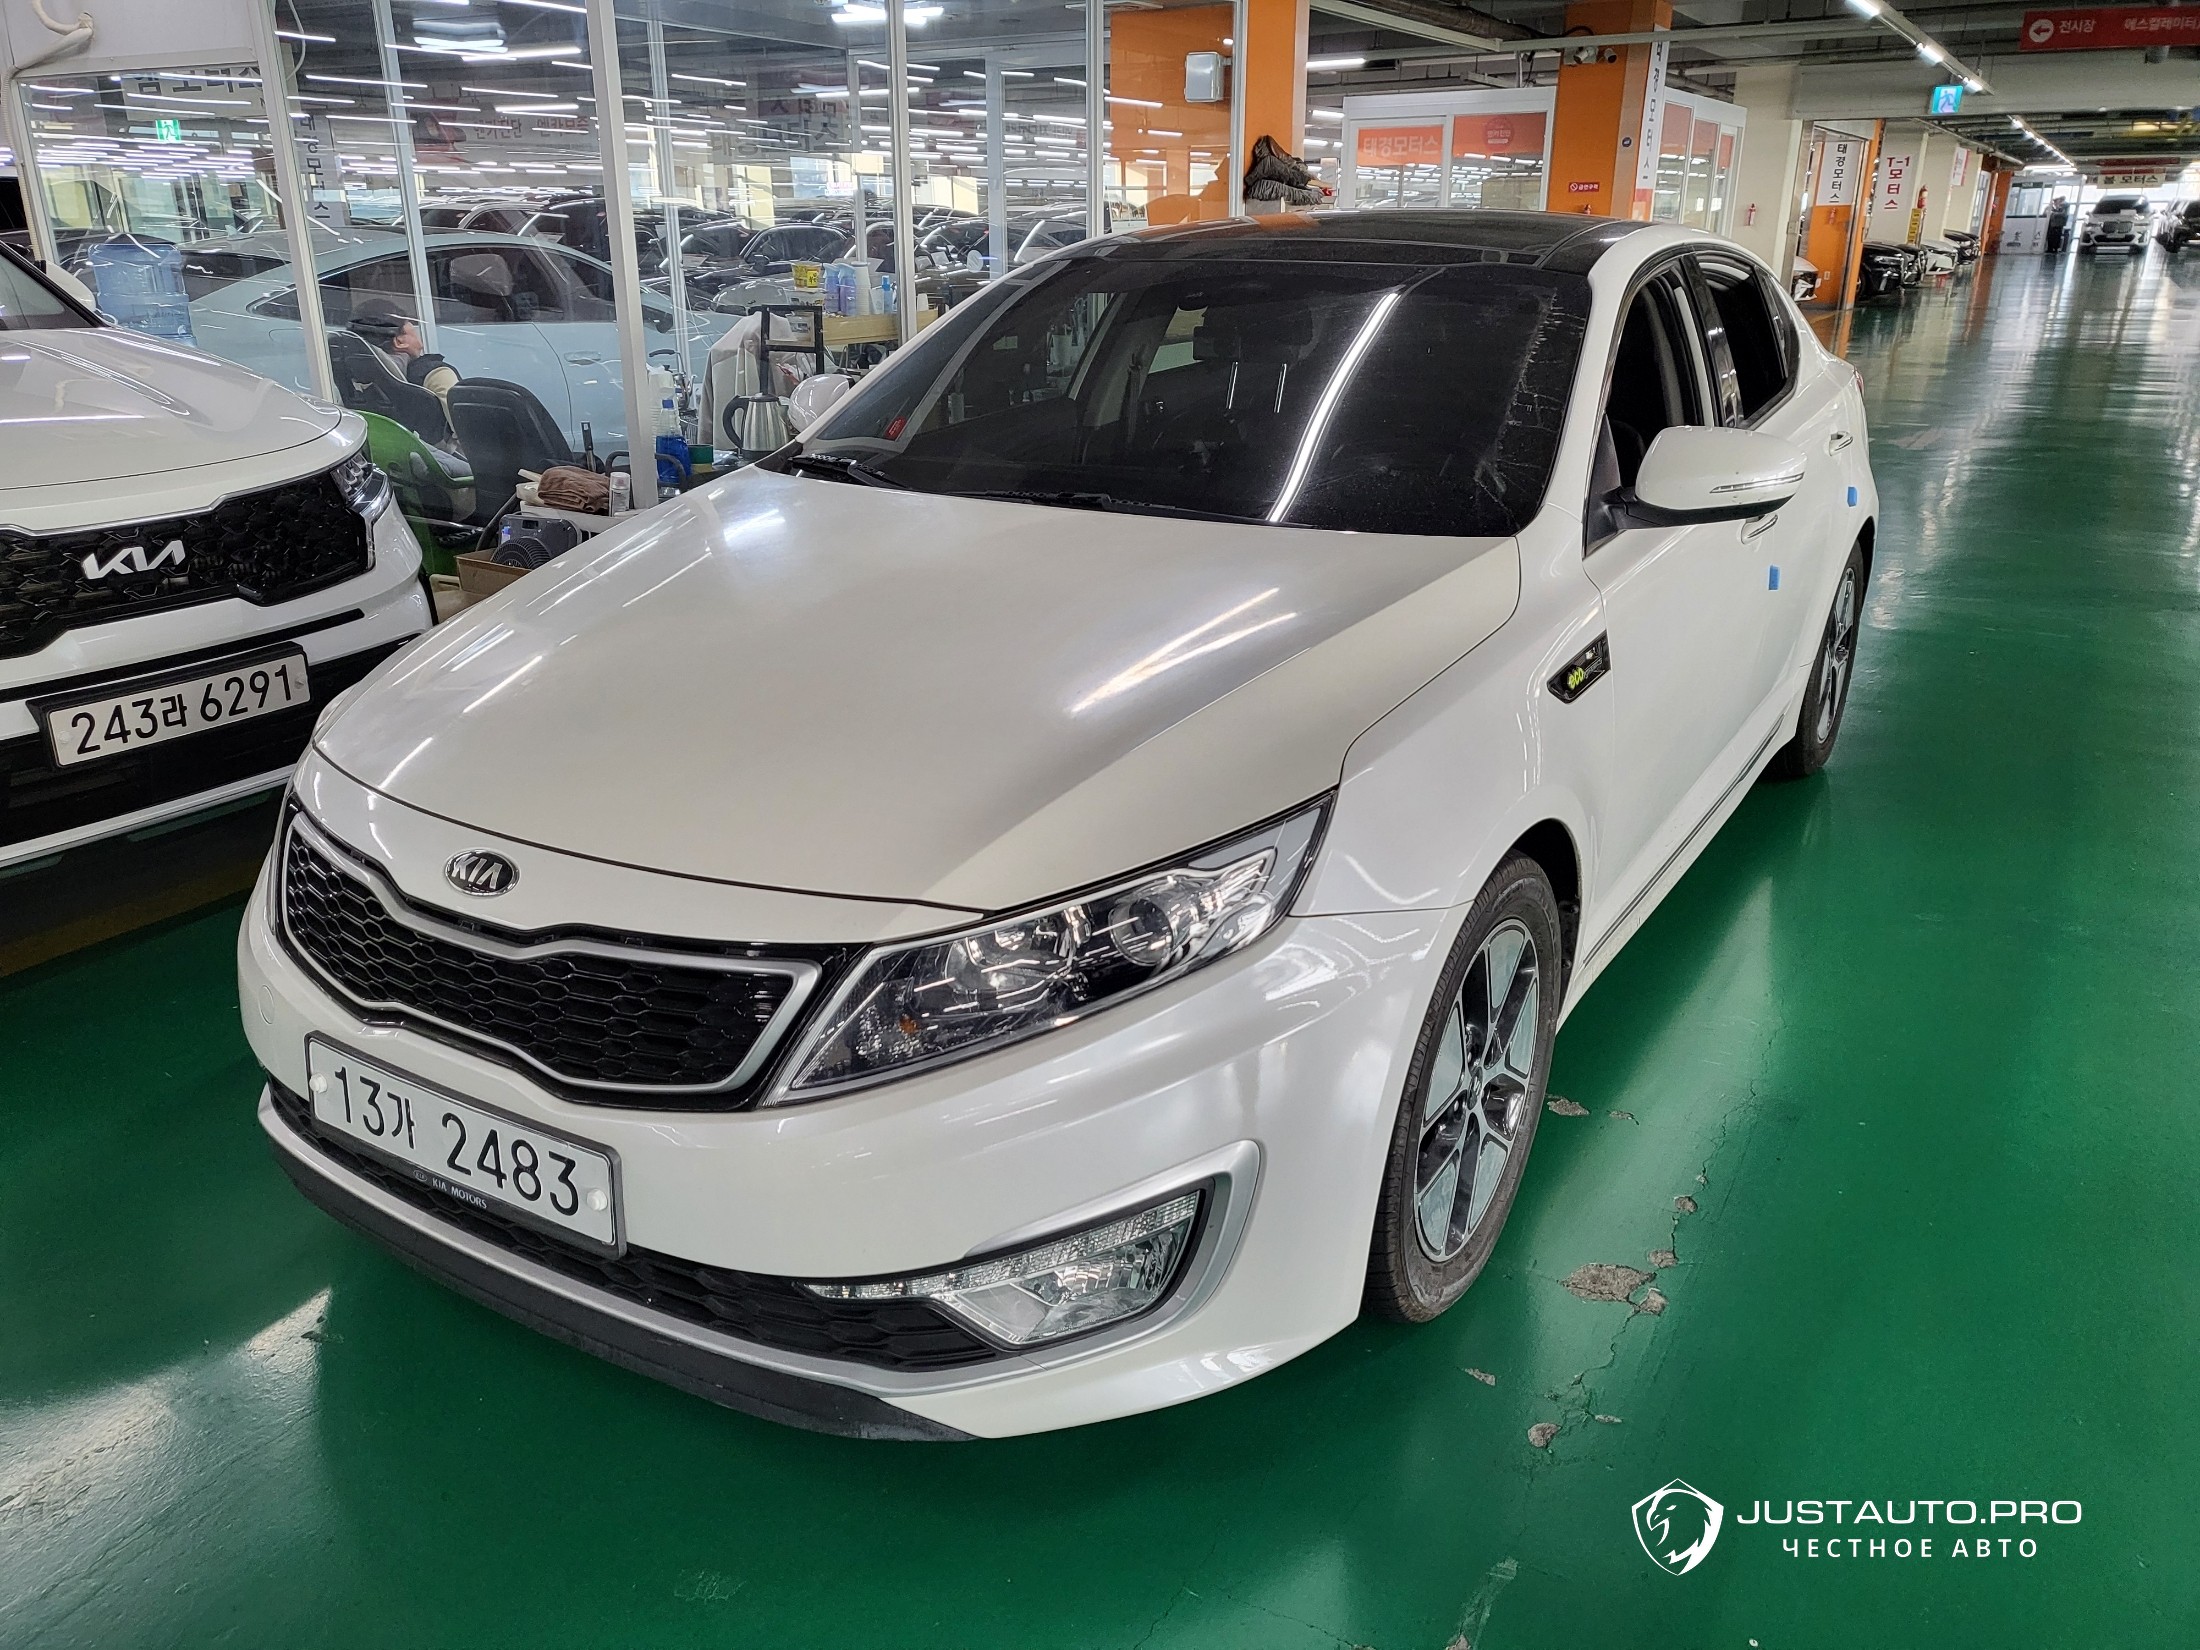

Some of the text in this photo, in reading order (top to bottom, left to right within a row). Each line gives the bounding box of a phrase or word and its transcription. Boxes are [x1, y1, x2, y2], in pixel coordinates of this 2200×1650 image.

[2058, 19, 2097, 34] 전시장
[1362, 135, 1440, 158] 태경모터스
[1887, 156, 1910, 167] T-1
[1829, 143, 1848, 203] 태경모터스
[1884, 168, 1903, 209] 모터스
[81, 539, 186, 580] KIA
[71, 664, 291, 755] 243라 6291
[450, 853, 503, 890] KIA
[335, 1066, 579, 1216] 13가 2483
[432, 1177, 488, 1209] KIA MOTORS
